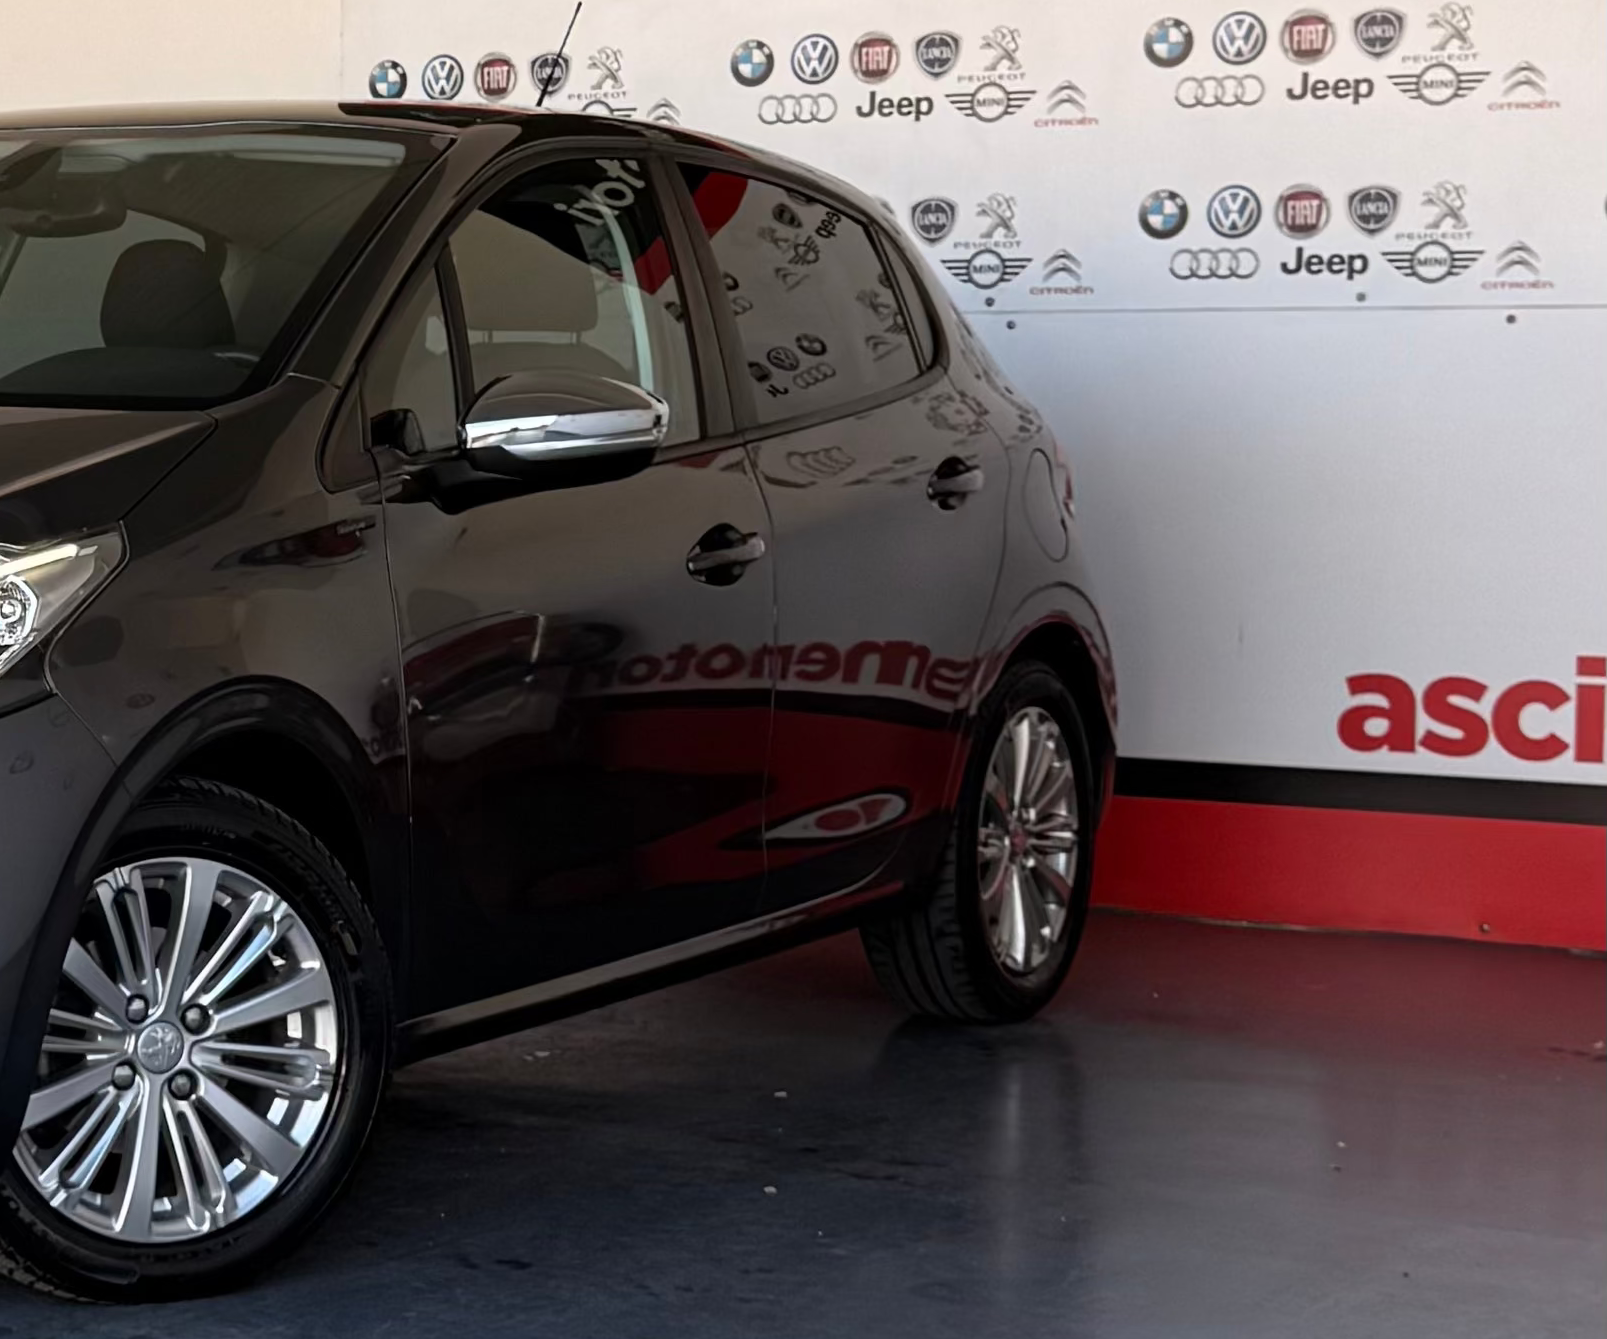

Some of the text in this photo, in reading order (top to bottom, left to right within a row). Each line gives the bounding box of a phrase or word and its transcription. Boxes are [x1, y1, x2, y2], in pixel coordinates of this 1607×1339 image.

[1293, 23, 1326, 51] FIAT
[861, 45, 891, 71] FIAT
[483, 65, 509, 90] FIAT
[1285, 71, 1375, 105] Jeep
[1421, 78, 1455, 90] MINI
[855, 90, 934, 121] Jeep
[975, 97, 1005, 109] MINI
[1286, 198, 1320, 225] FIAT
[972, 263, 1000, 274] MINI
[1280, 246, 1370, 281] Jeep
[1415, 255, 1448, 267] MINI
[1336, 655, 1607, 765] asci
